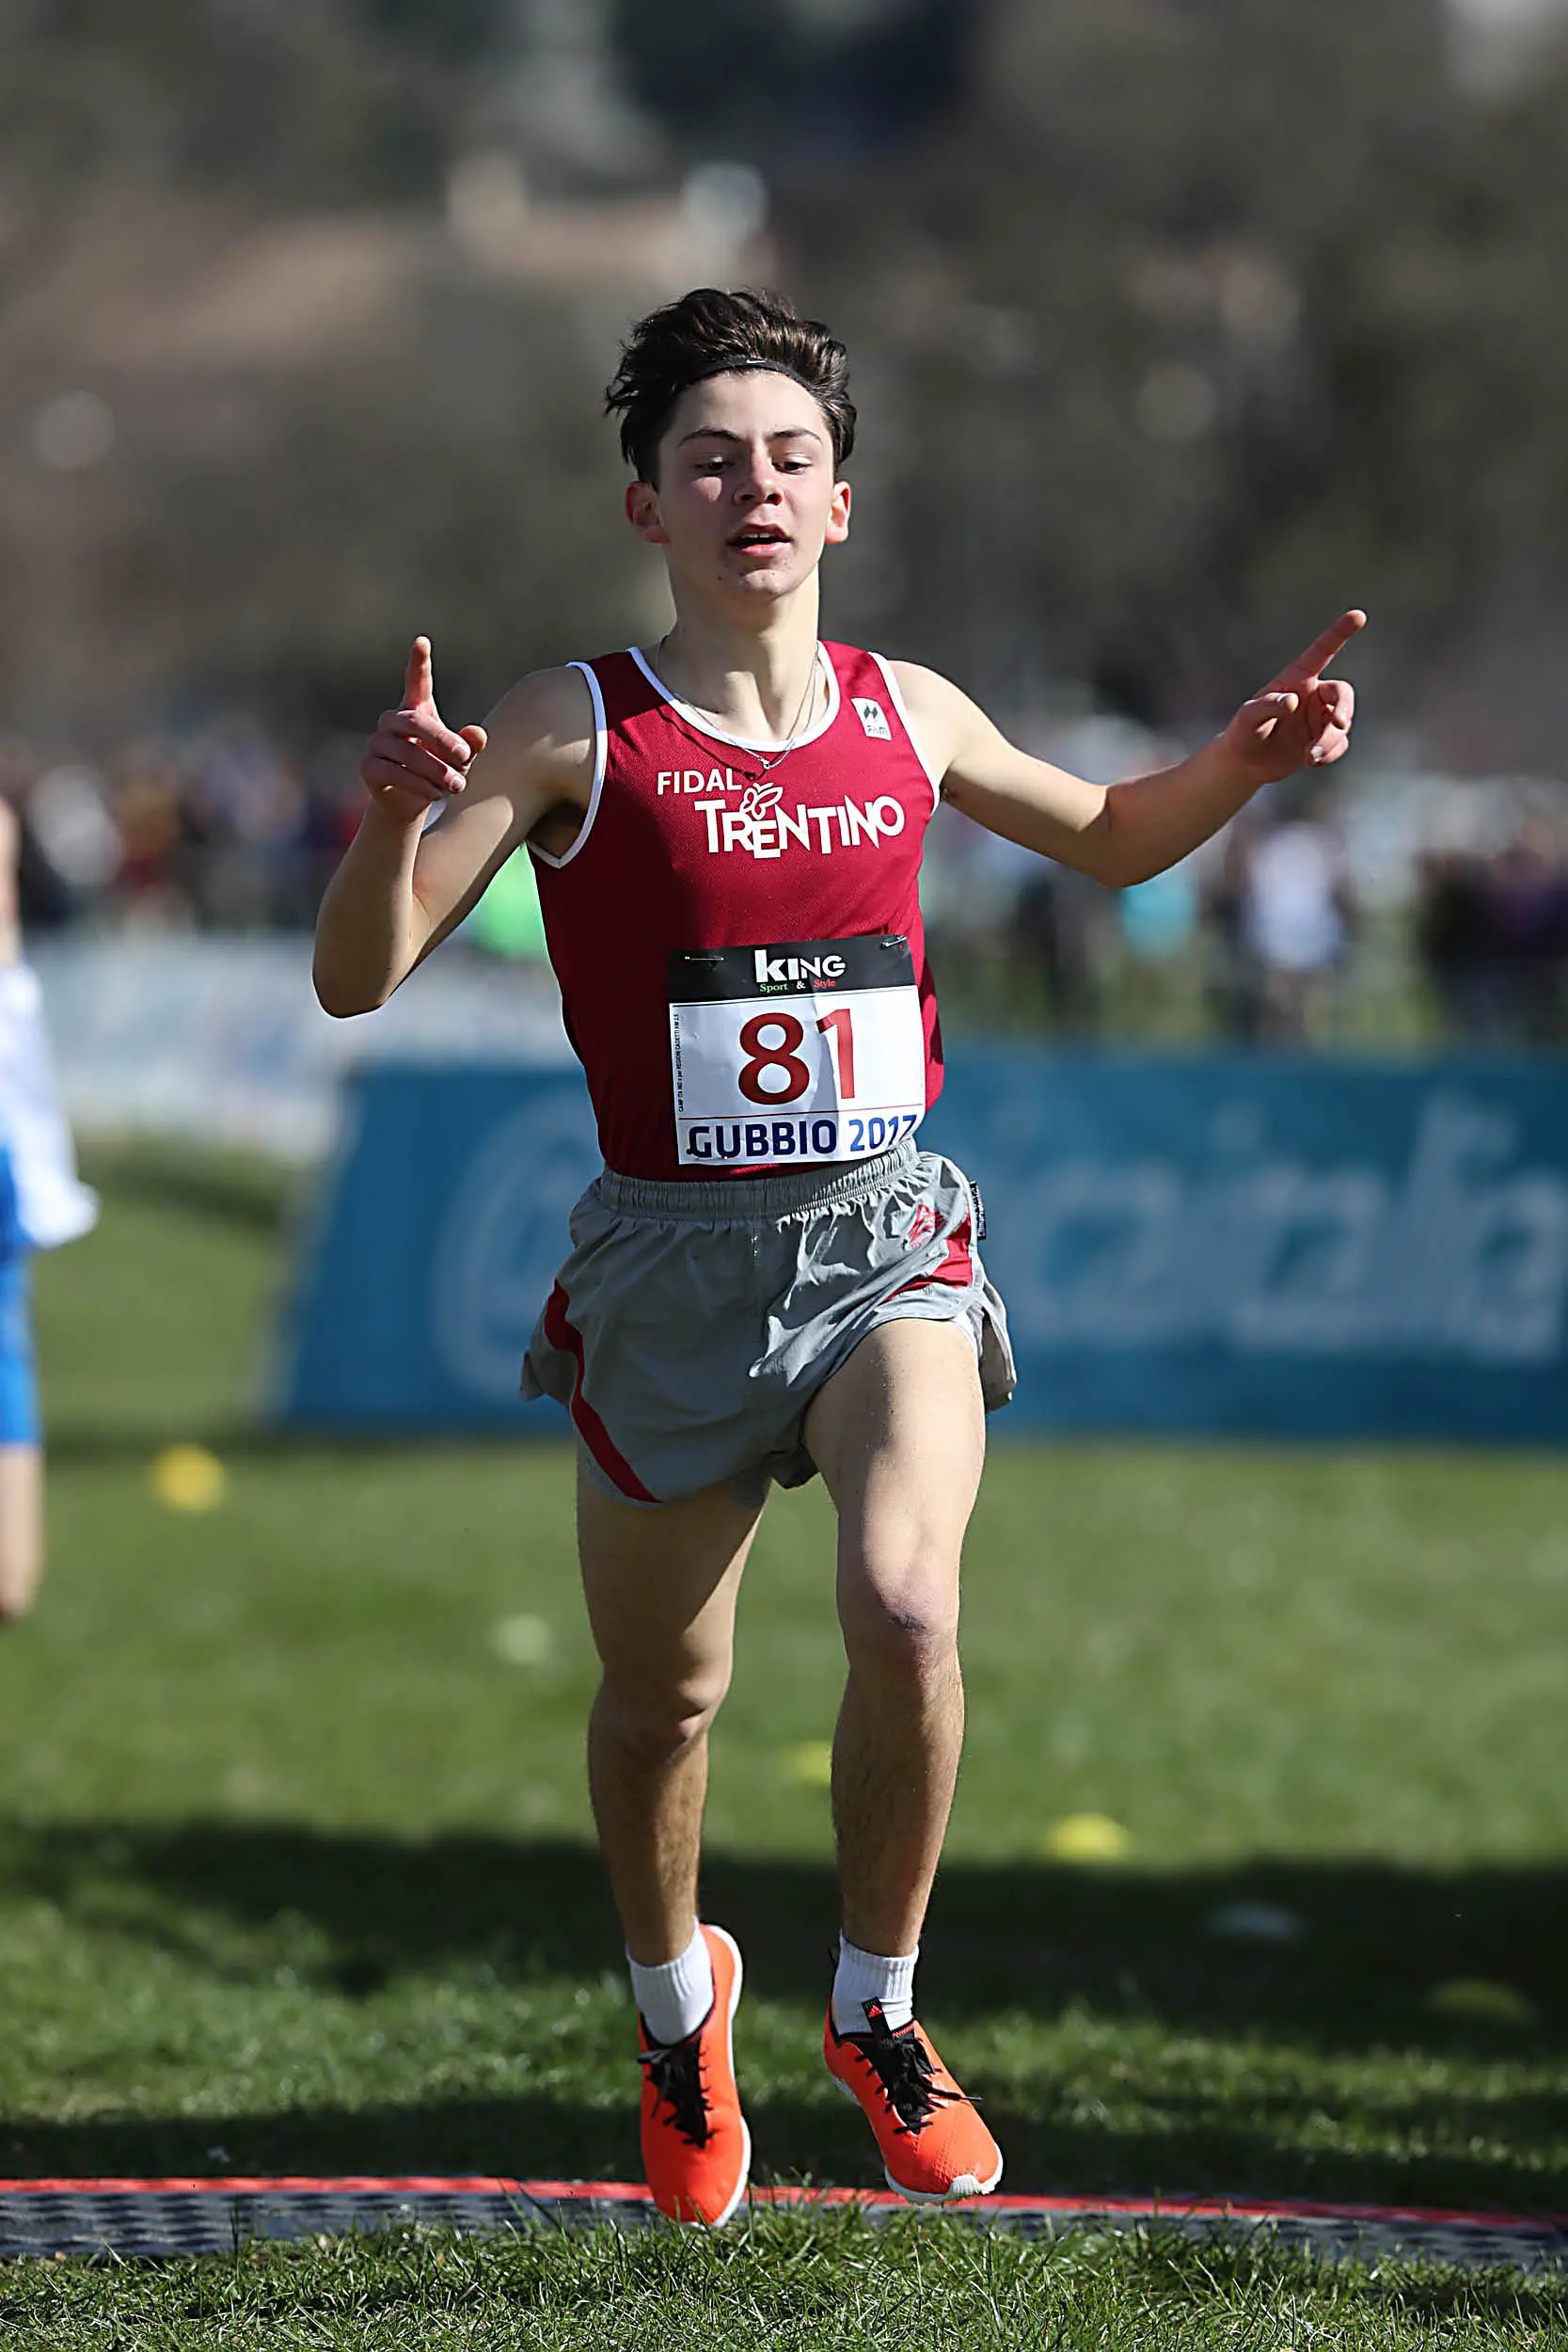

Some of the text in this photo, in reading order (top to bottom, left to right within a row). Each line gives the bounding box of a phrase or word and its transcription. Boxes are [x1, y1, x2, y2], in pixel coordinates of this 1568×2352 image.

[657, 768, 742, 795] FIDAL
[694, 795, 905, 859] TRENTINO
[759, 978, 836, 993] Sport & Style
[738, 1009, 855, 1105] 81
[688, 1115, 917, 1159] GUBBIO 2017
